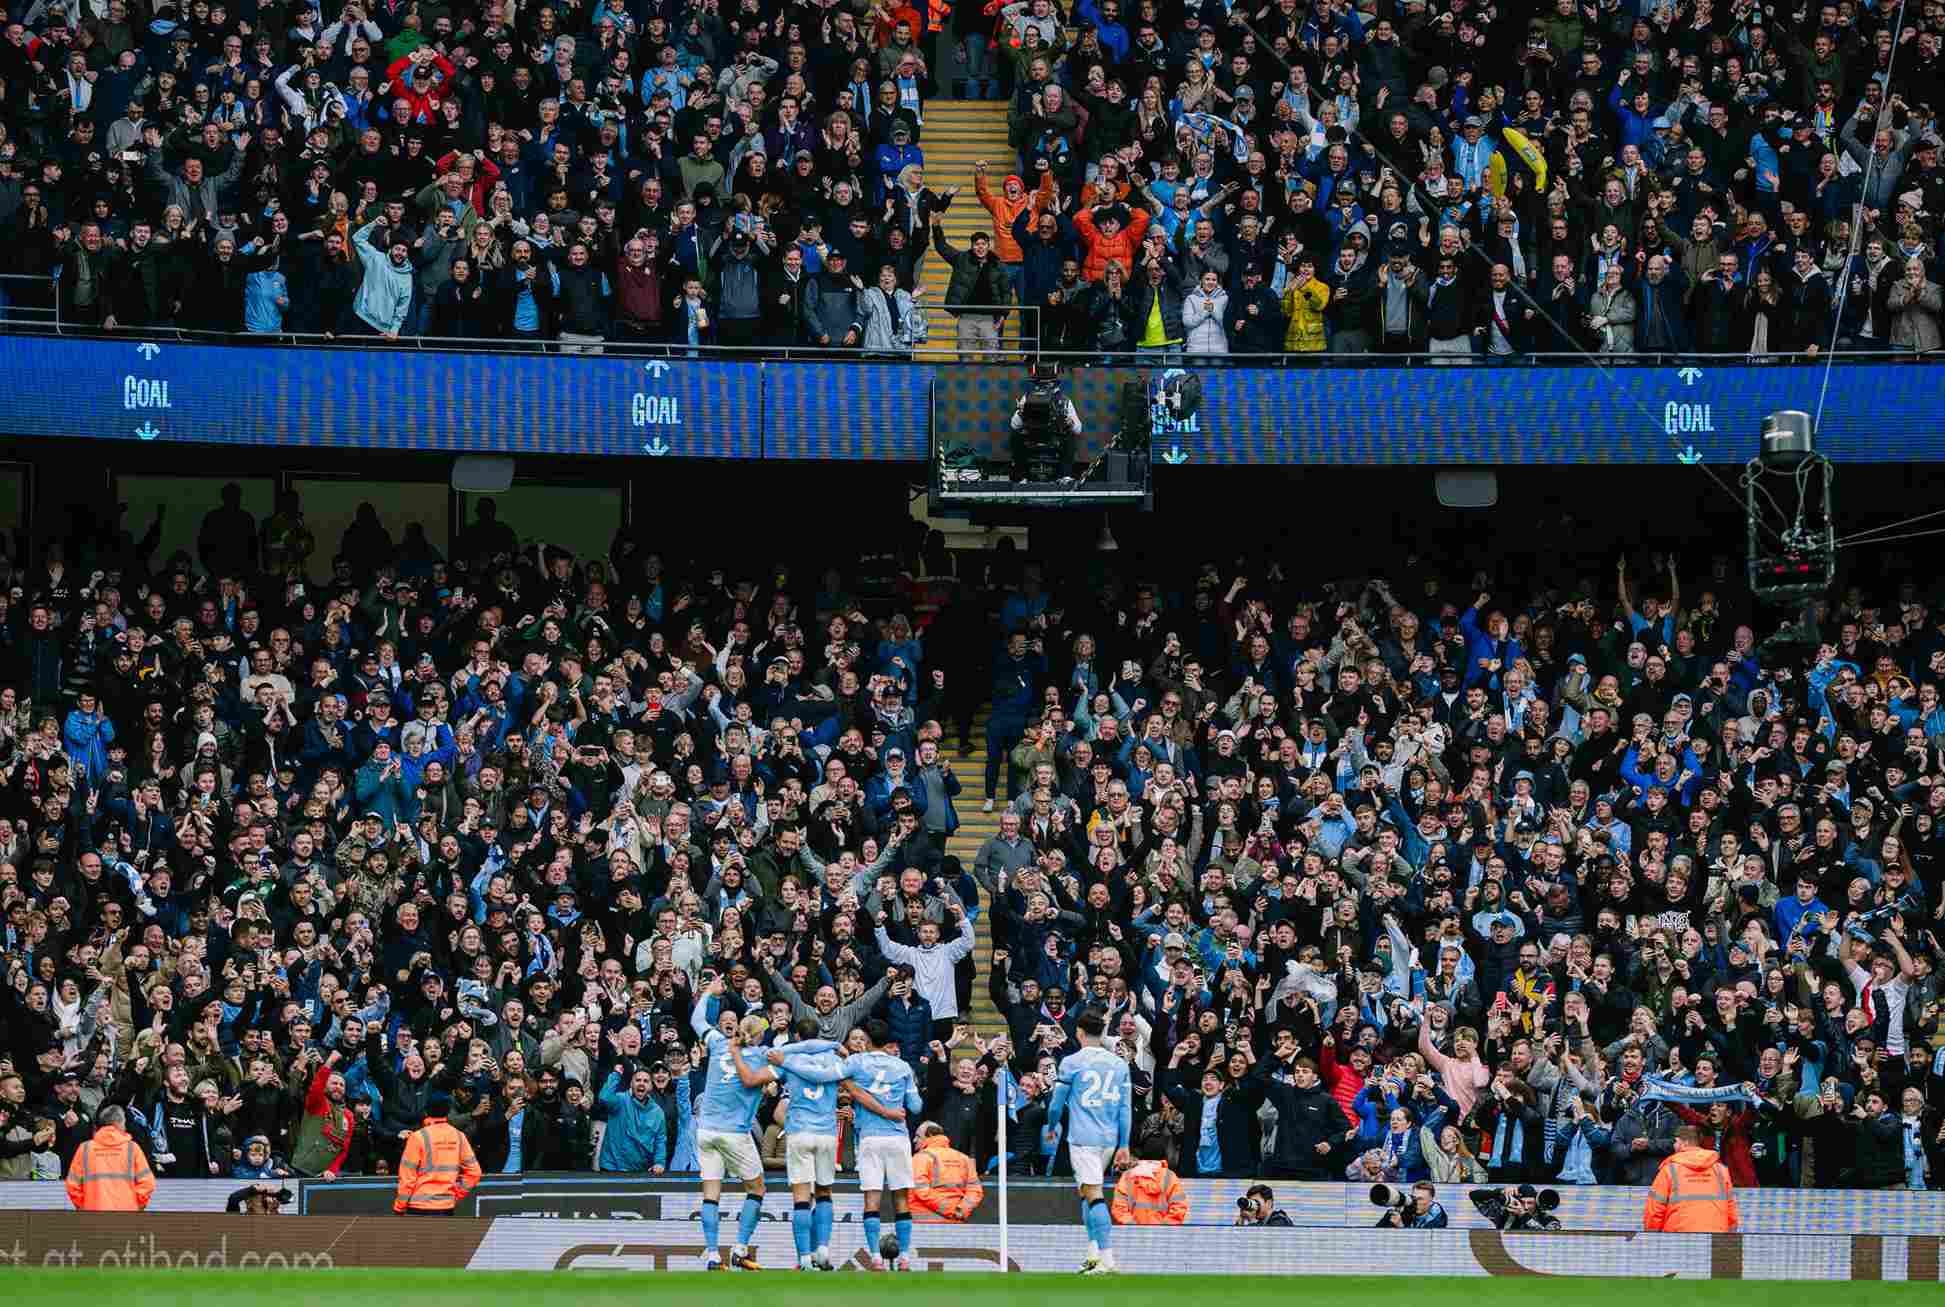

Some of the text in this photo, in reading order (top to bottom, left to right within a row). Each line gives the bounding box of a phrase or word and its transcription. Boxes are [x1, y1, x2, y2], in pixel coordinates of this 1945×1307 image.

[124, 374, 172, 410] GOAL
[632, 392, 682, 426] GOAL
[1665, 401, 1715, 434] GOAL
[1079, 1069, 1121, 1108] 24
